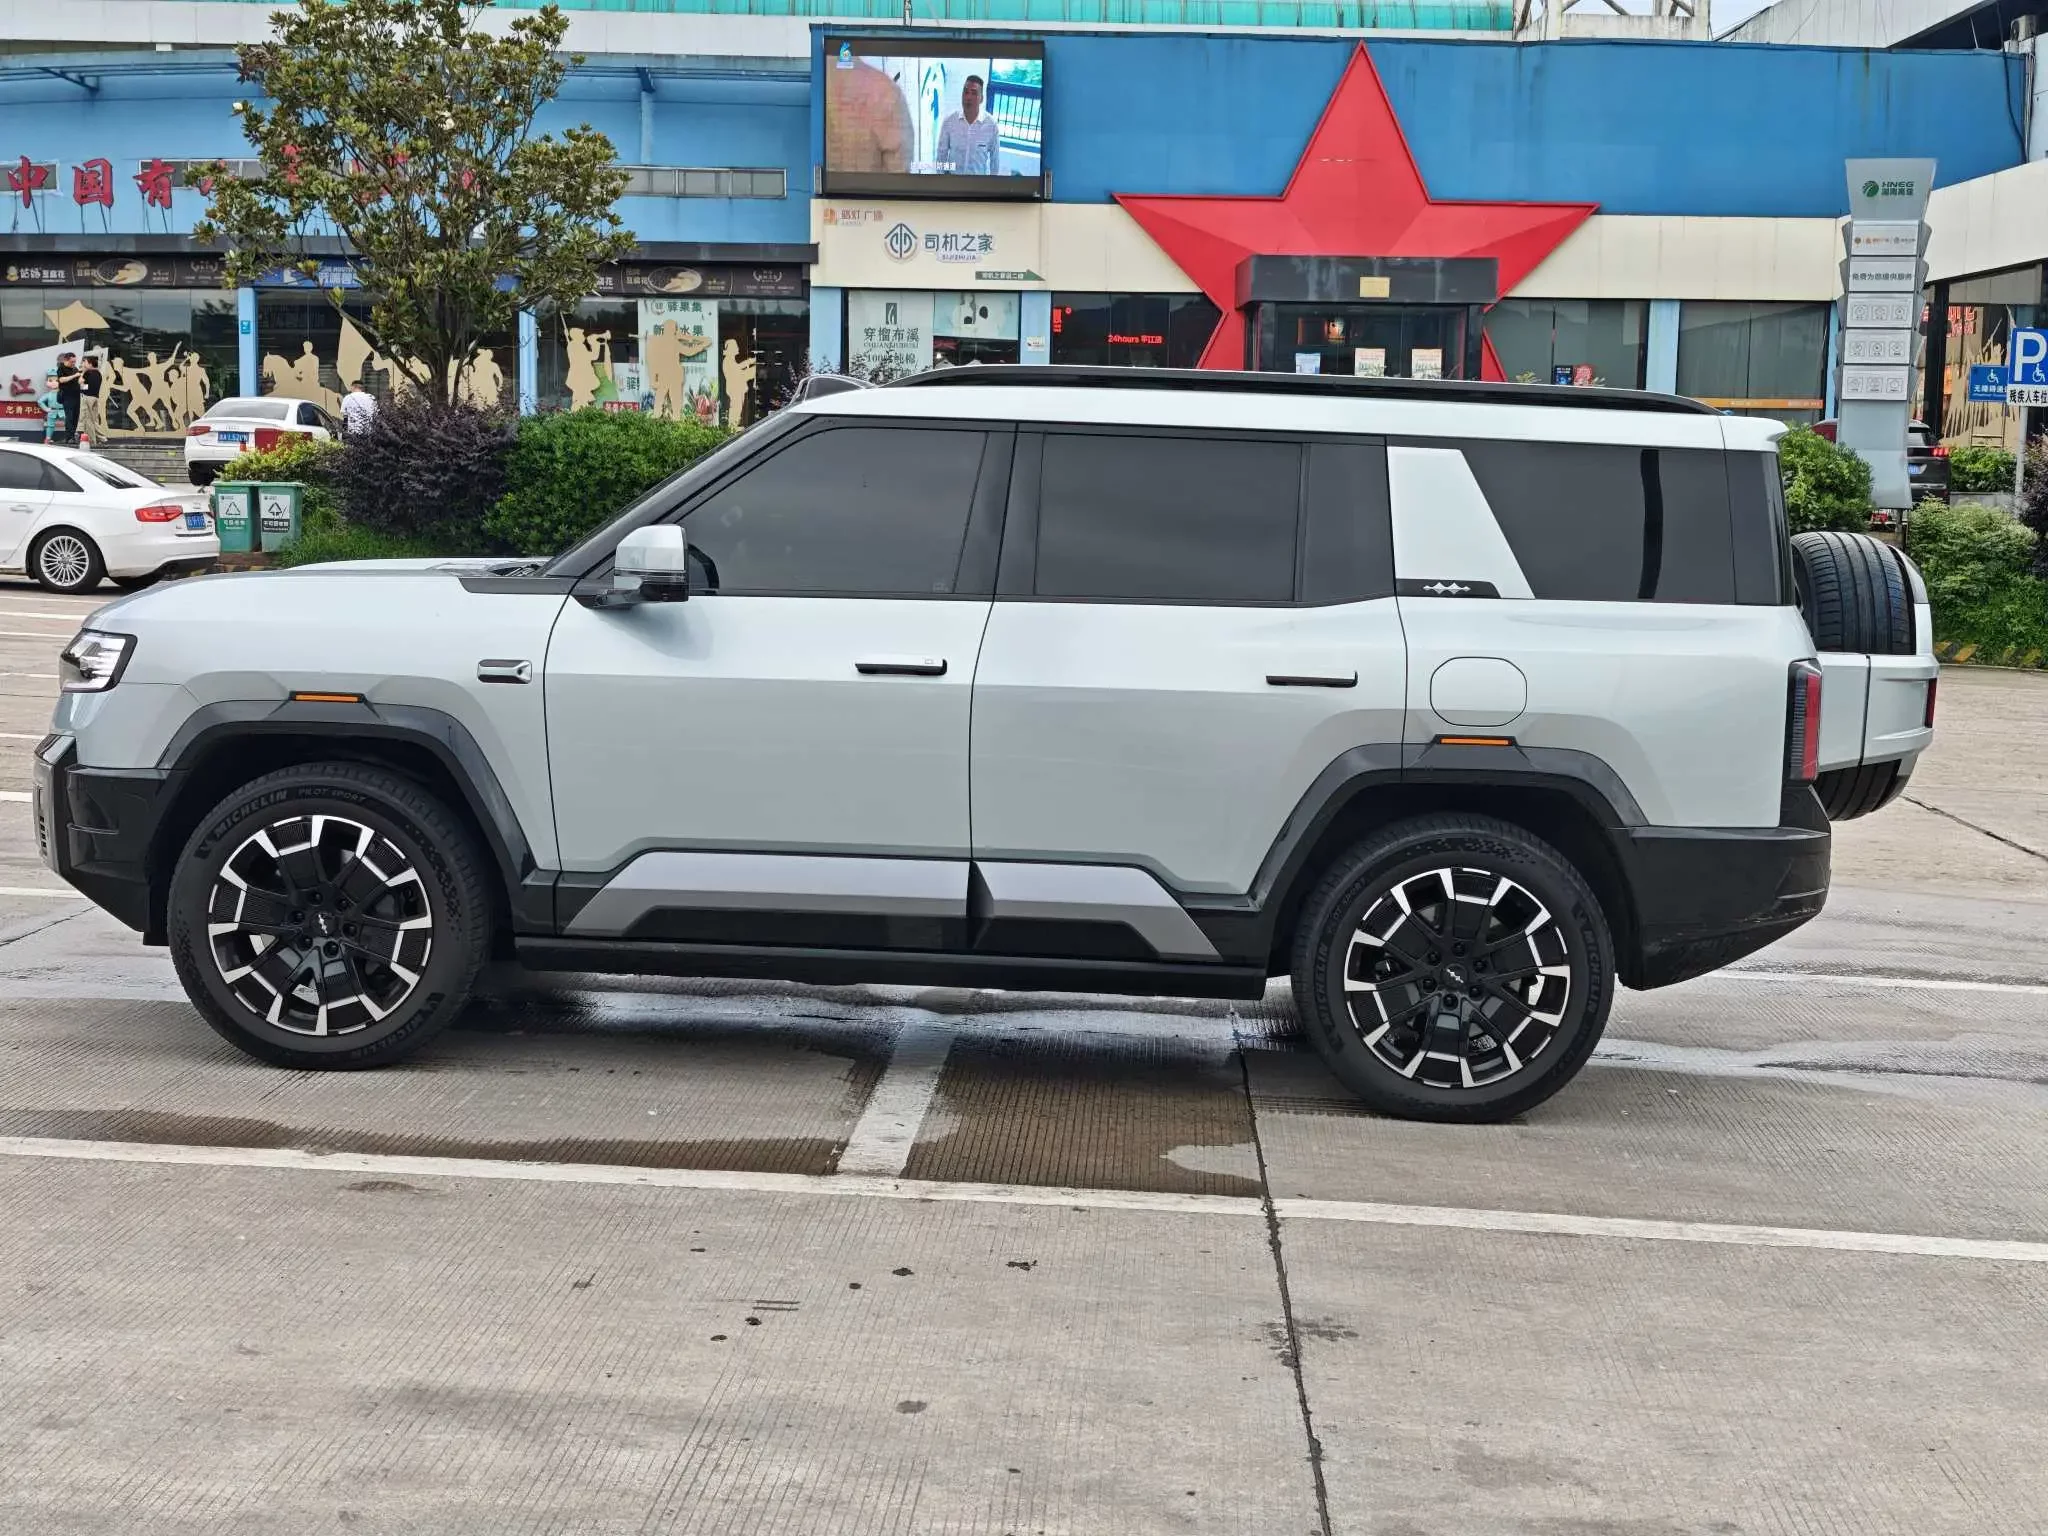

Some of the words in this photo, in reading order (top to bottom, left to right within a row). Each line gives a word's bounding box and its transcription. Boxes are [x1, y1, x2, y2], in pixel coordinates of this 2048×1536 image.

[923, 233, 994, 253] 司机之家
[2014, 331, 2048, 382] P
[214, 788, 289, 838] MICHELIN
